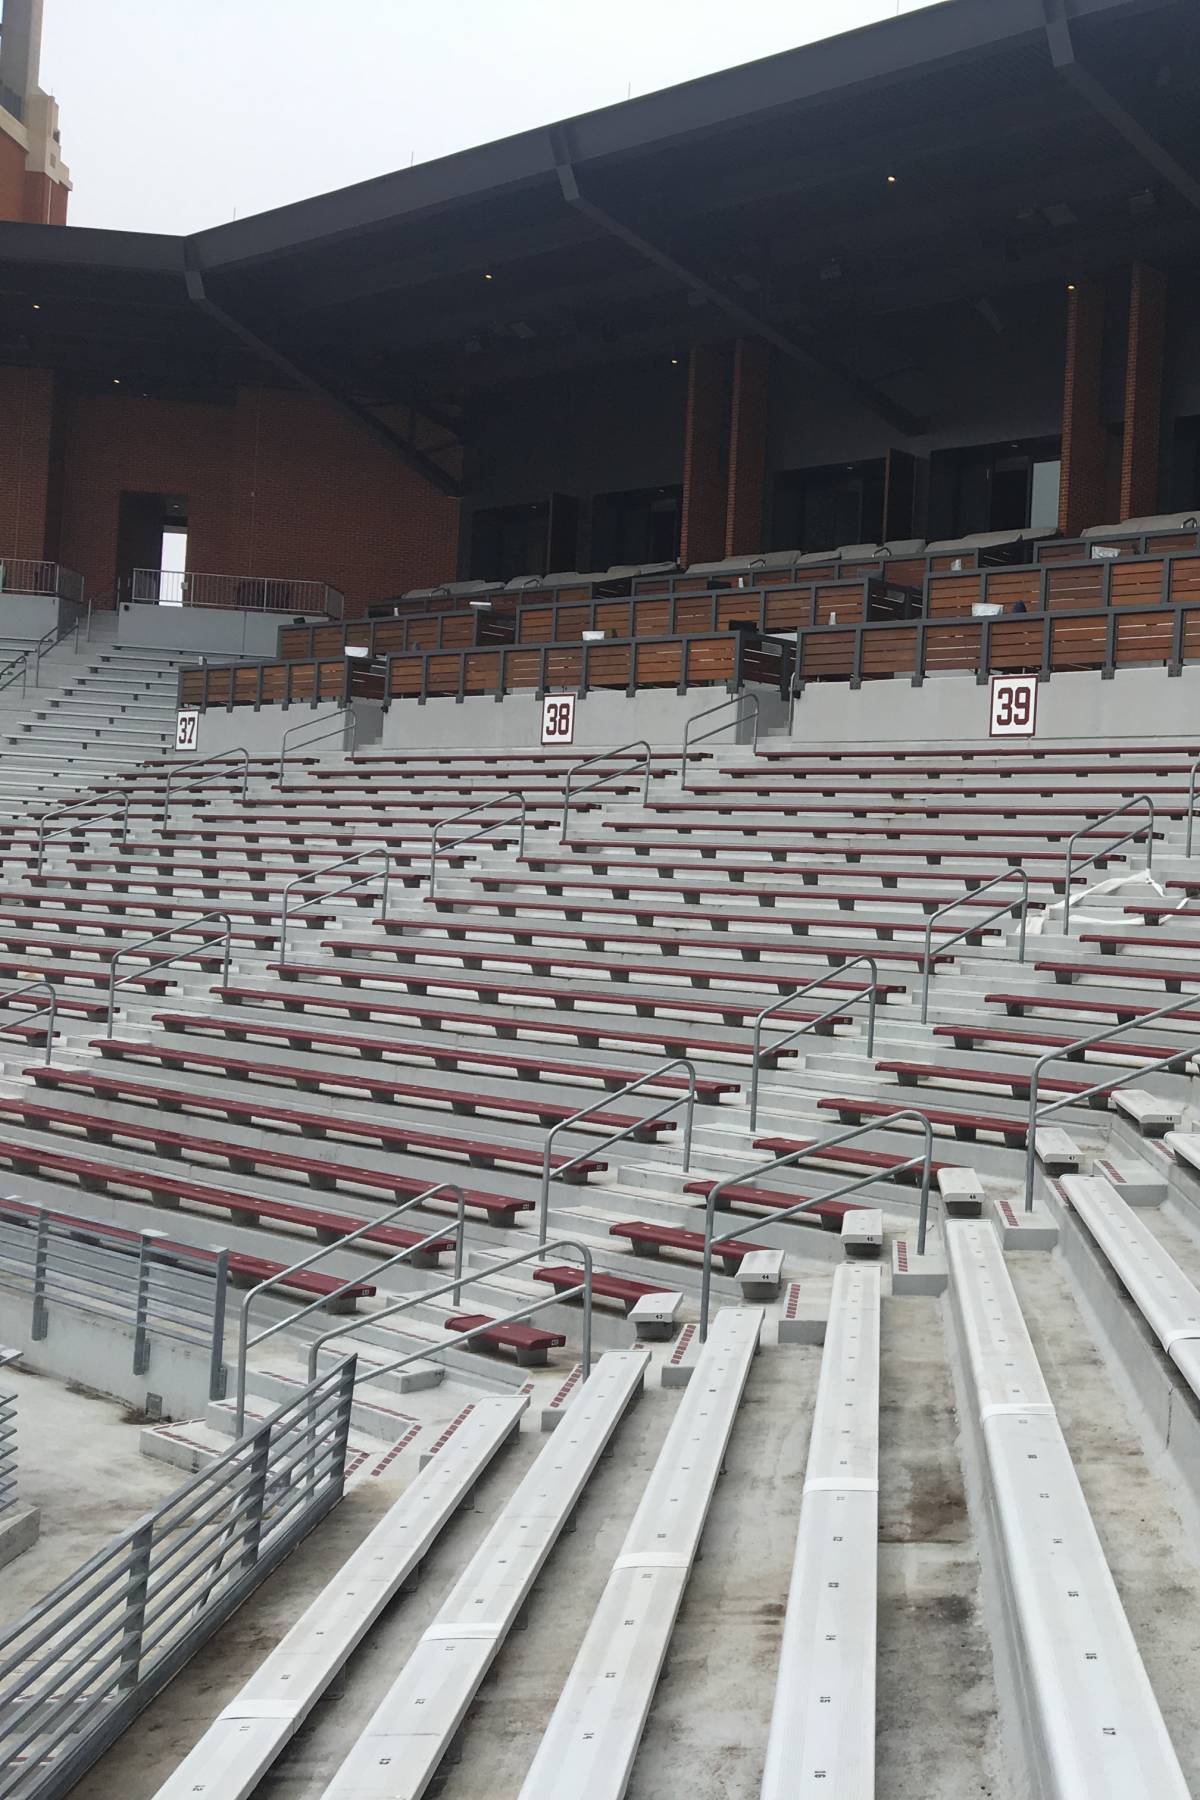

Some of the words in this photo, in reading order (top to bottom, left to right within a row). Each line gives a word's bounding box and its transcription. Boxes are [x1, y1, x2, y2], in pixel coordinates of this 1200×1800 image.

[545, 702, 571, 736] 38
[996, 686, 1031, 726] 39
[178, 716, 196, 745] 37
